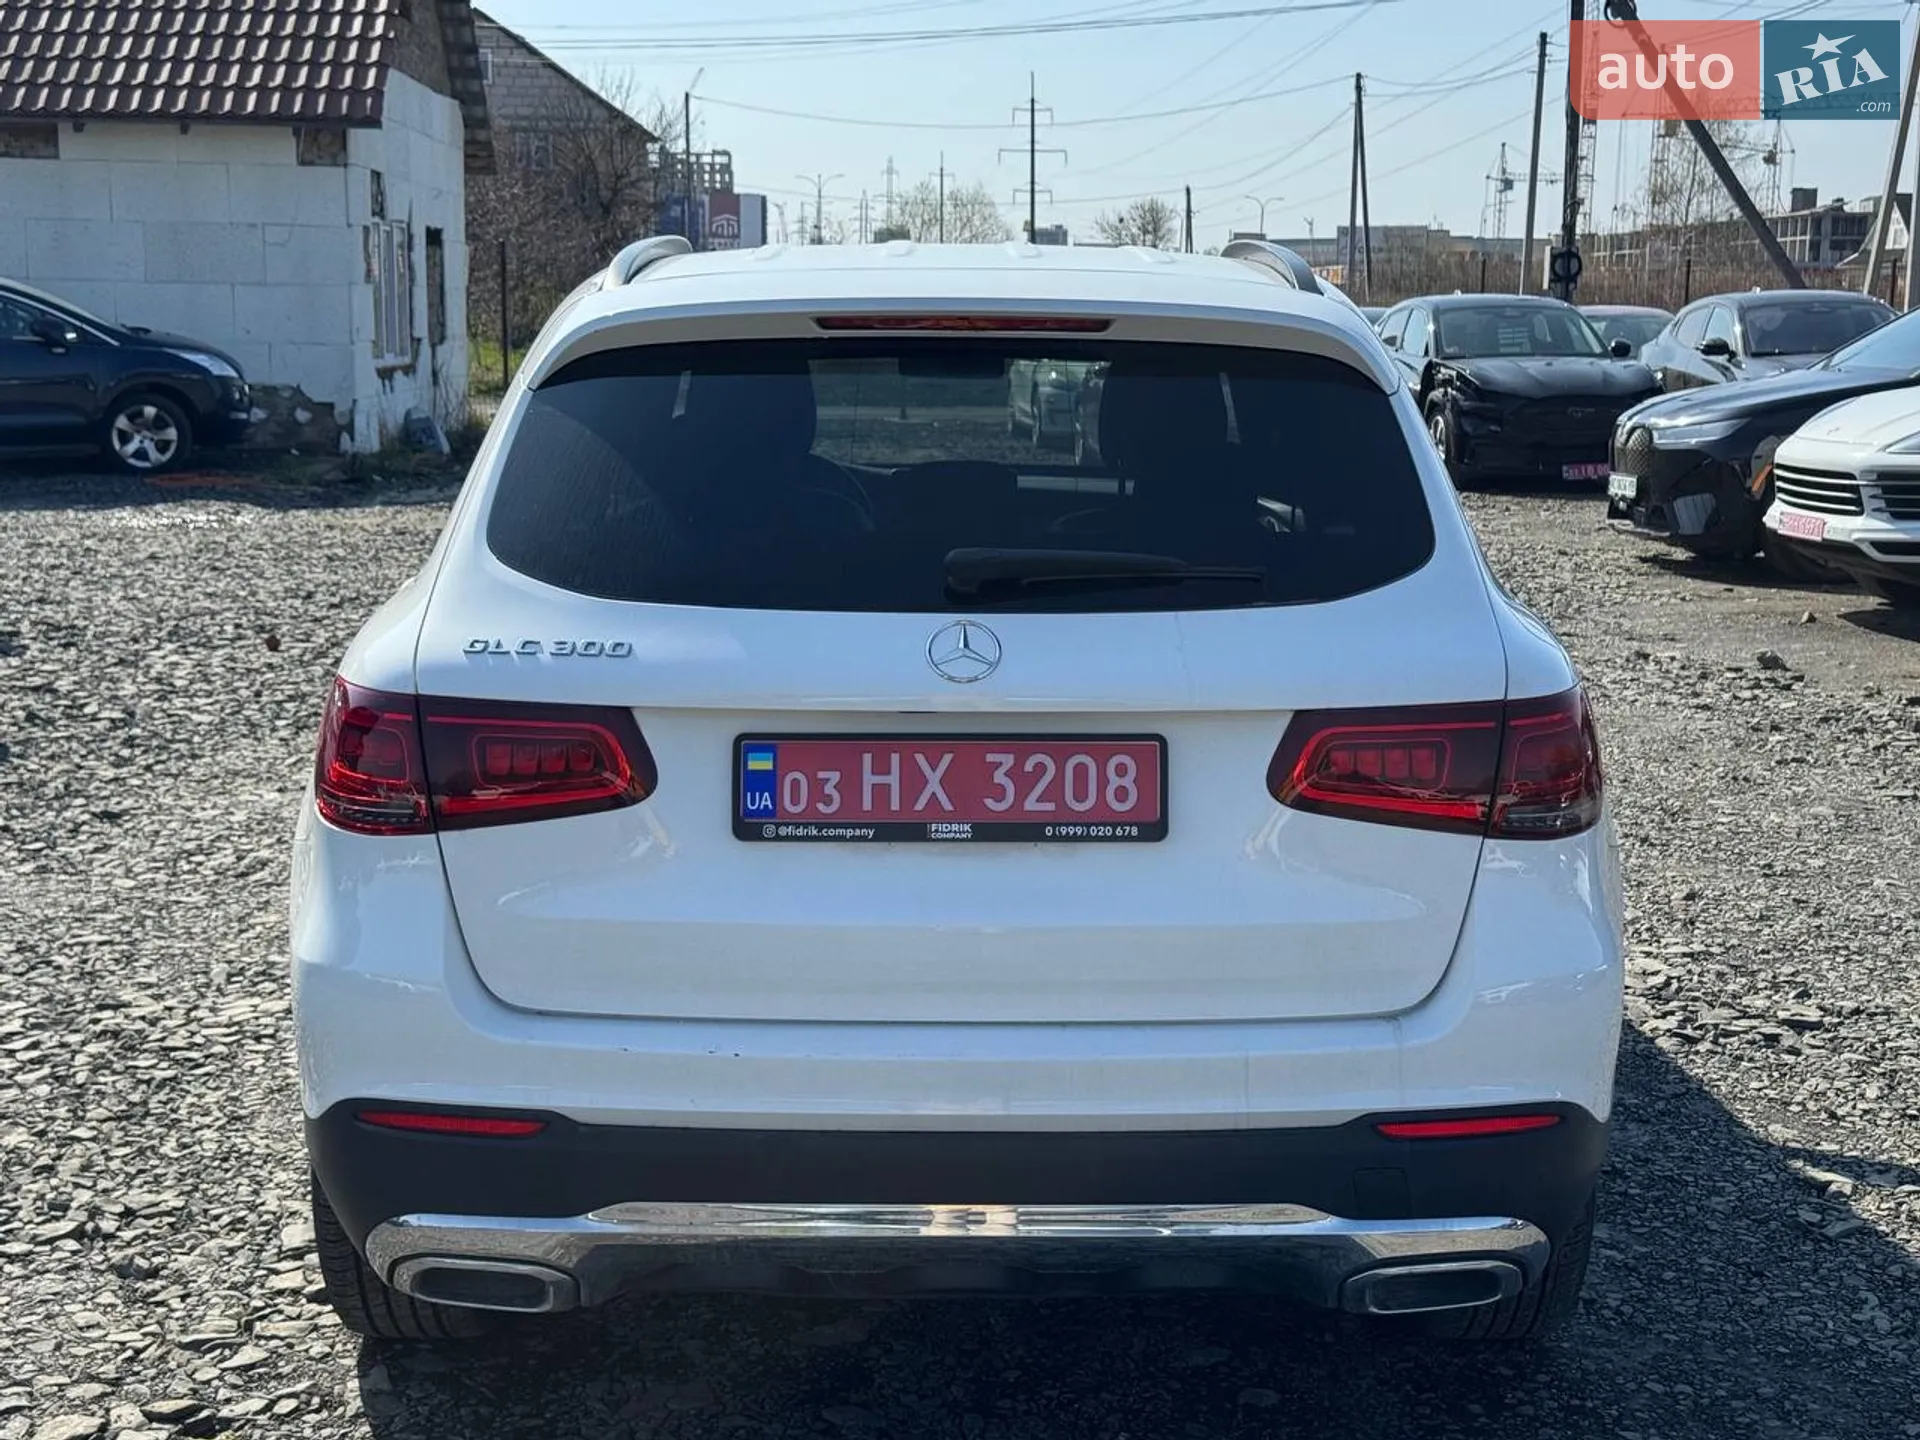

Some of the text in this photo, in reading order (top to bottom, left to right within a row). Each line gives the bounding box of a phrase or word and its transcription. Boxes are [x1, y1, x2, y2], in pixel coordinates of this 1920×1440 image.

[463, 637, 634, 657] GLC 300
[783, 753, 1139, 814] 03 HX 3208
[747, 792, 774, 810] UA
[778, 824, 876, 839] @fidrik.company
[931, 823, 972, 832] FIDRIK
[1045, 826, 1139, 837] 0 (999) 020 678
